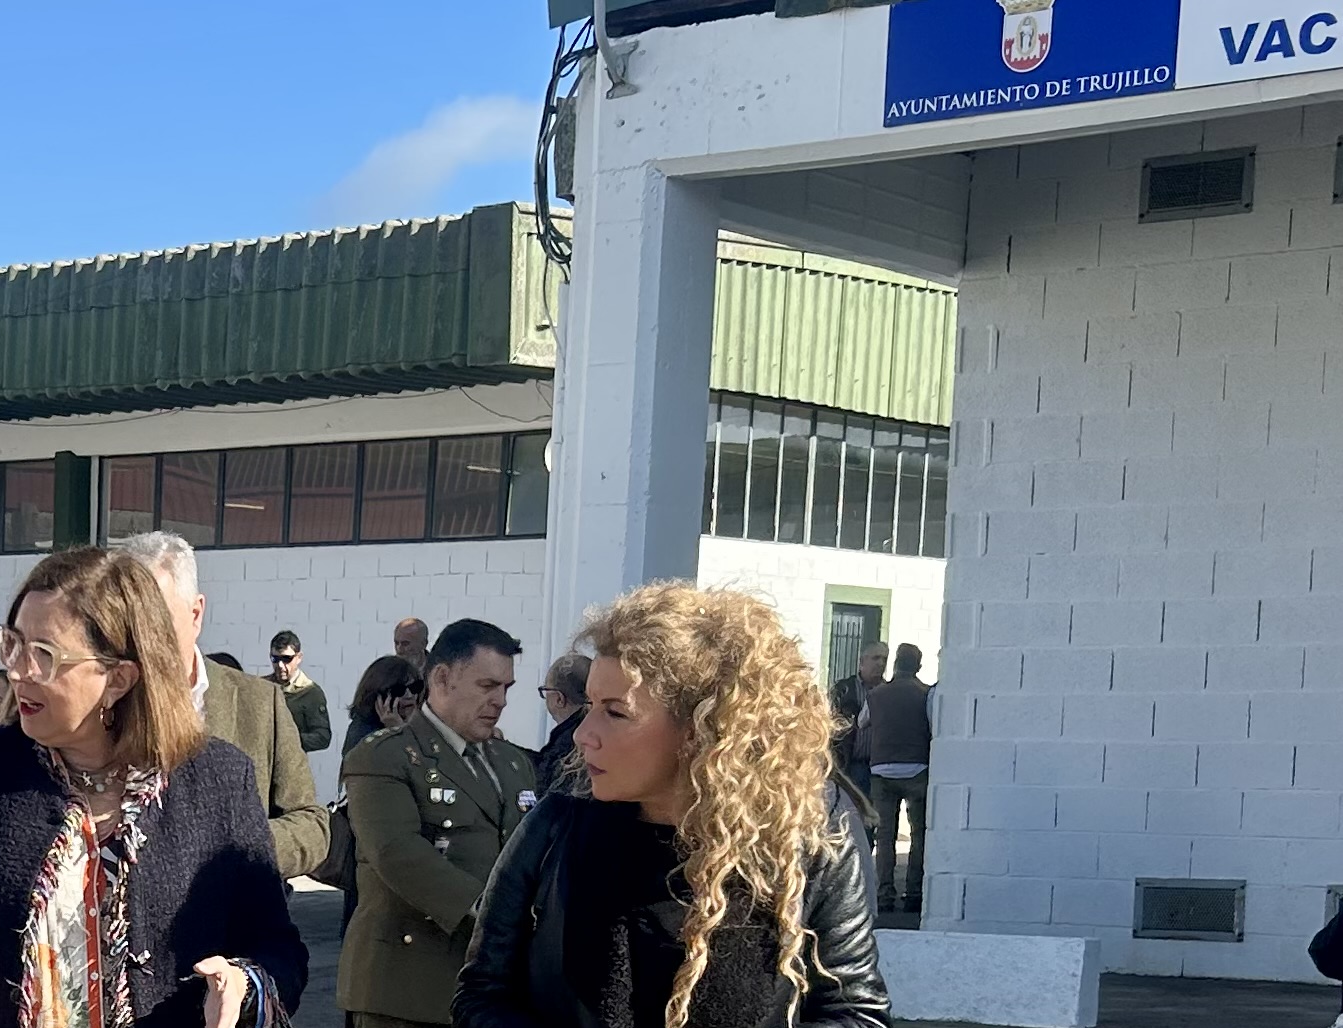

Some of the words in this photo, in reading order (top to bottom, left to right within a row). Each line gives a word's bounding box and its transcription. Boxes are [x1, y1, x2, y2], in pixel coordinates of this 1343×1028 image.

[1219, 12, 1338, 65] VAC
[887, 83, 1039, 118] AYUNTAMIENTO
[1045, 79, 1071, 97] DE
[1076, 65, 1170, 94] TRUJILLO
